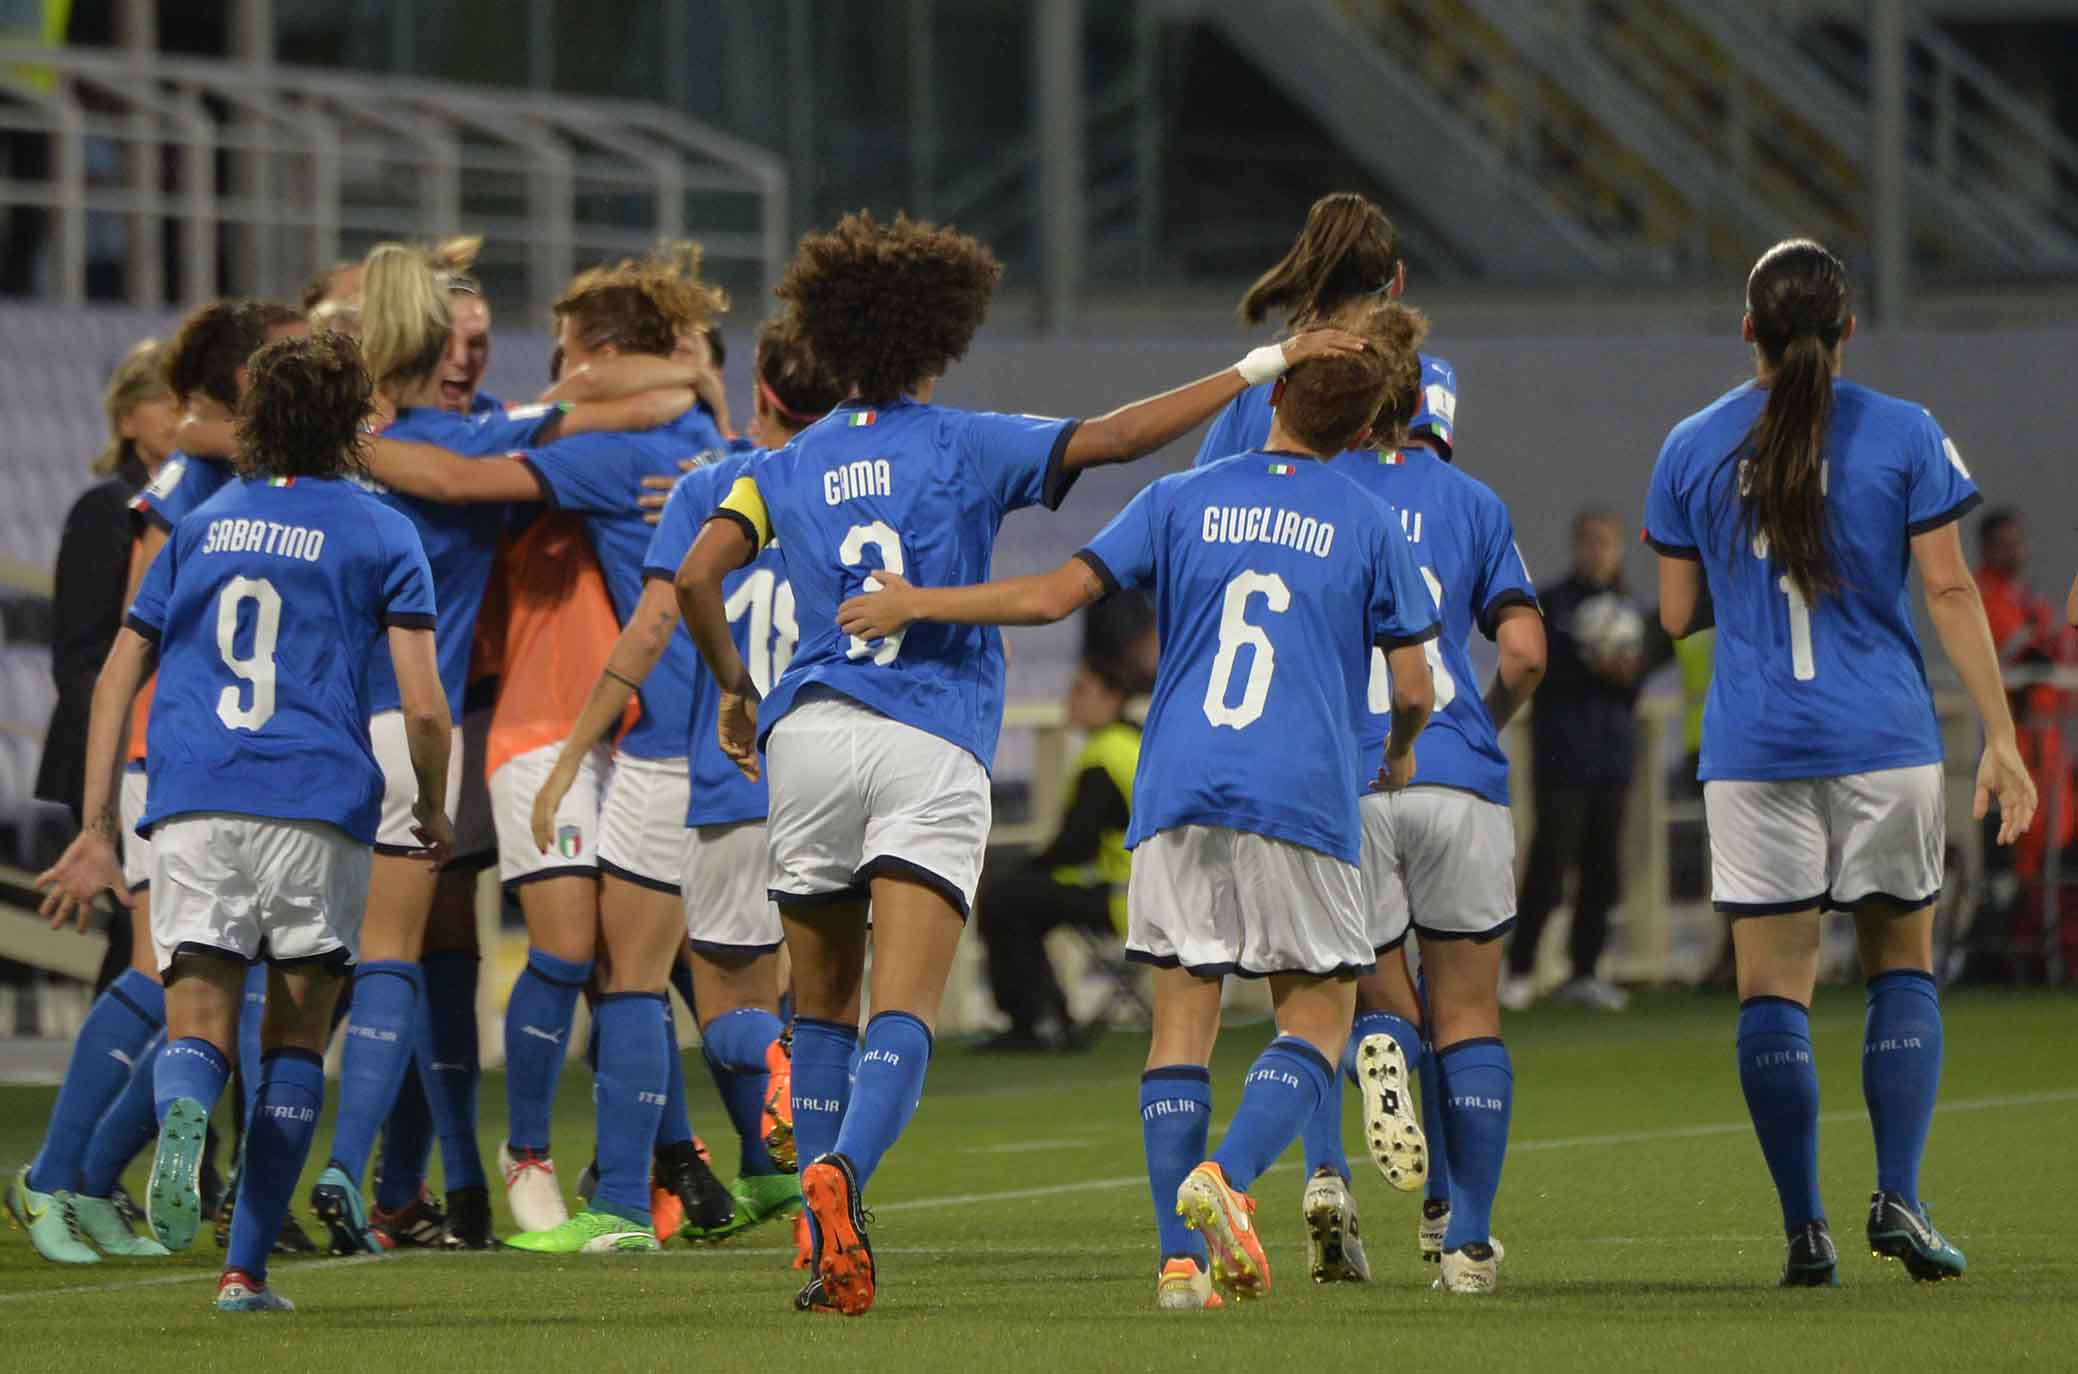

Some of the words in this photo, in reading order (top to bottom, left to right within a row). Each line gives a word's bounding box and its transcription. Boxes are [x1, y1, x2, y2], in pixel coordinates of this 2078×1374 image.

[203, 519, 325, 562] SABATINO
[1202, 506, 1334, 558] GIUGLIANO
[216, 575, 282, 731] 9
[1203, 569, 1291, 731] 6
[1244, 1069, 1299, 1089] ITALIA
[791, 1097, 840, 1113] ITALIA
[1143, 1099, 1196, 1121] ITALIA
